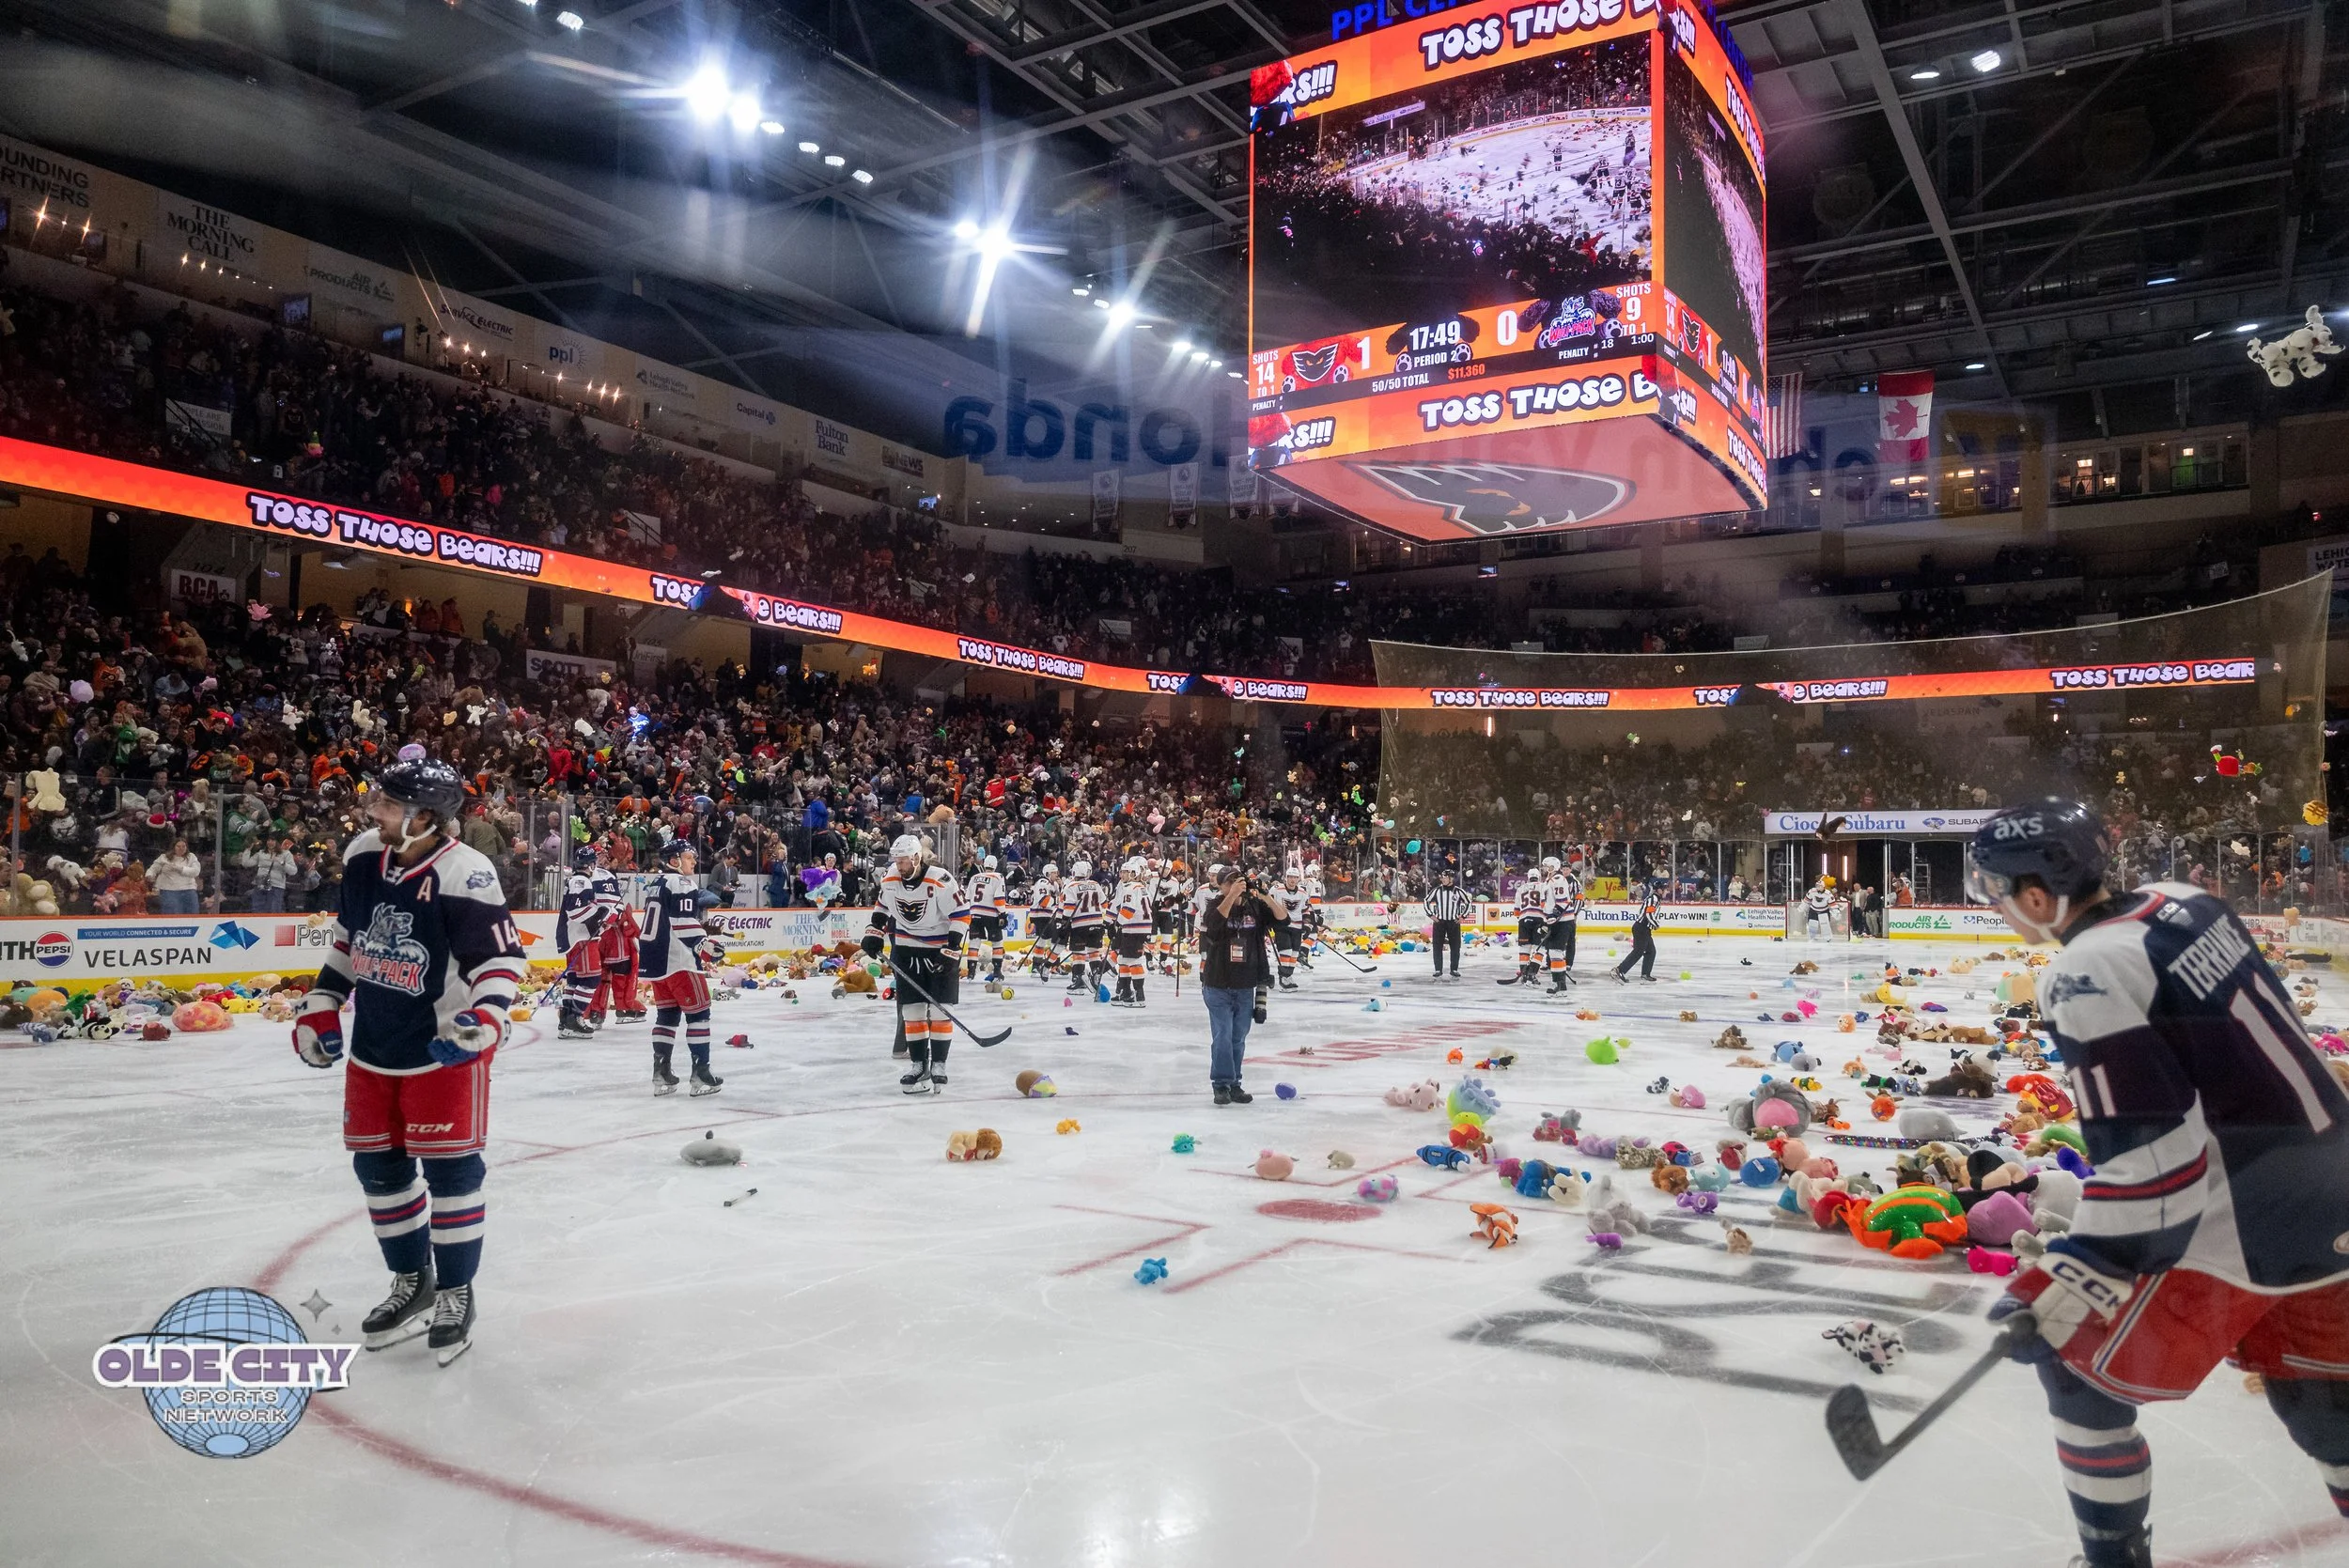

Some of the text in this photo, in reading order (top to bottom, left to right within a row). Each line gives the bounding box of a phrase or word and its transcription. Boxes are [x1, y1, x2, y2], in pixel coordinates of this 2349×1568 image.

[192, 204, 230, 229] THE
[167, 212, 255, 253] MORNING
[188, 236, 234, 261] CALL
[1617, 282, 1652, 298] SHOTS
[1626, 297, 1641, 320] 9
[1409, 320, 1461, 350] 17:49
[1497, 310, 1517, 346] 0
[1601, 339, 1613, 349] 18
[1631, 334, 1654, 345] 1:00
[549, 343, 574, 365] ppl
[1252, 350, 1279, 365] SHOTS
[1357, 336, 1370, 369] 1
[1414, 352, 1447, 367] PERIOD
[1559, 348, 1589, 359] PENALTY
[1256, 363, 1275, 385] 14
[1372, 378, 1401, 392] 50/50
[1403, 373, 1429, 387] TOTAL
[1257, 385, 1275, 397] TO 1
[737, 402, 766, 420] Capital
[1252, 400, 1276, 411] PENALTY
[815, 420, 848, 442] Fulton
[817, 435, 847, 455] Bank
[179, 575, 219, 599] BCA
[1994, 815, 2045, 840] axs
[417, 876, 432, 903] A
[602, 883, 615, 893] 30
[926, 886, 934, 898] C
[973, 884, 986, 902] 5
[575, 897, 582, 908] 4
[679, 899, 692, 911] 10
[728, 915, 772, 930] ELECTRIC
[795, 913, 815, 924] THE
[1584, 910, 1620, 922] Fulton
[1658, 912, 1679, 921] PLAY
[1688, 912, 1708, 921] WIN!
[169, 928, 193, 937] SECURE
[490, 920, 522, 955] 14
[783, 924, 825, 937] MORNING
[36, 945, 70, 955] PEPSI
[84, 946, 212, 969] VELASPAN
[380, 956, 424, 989] PACK
[2070, 1063, 2118, 1121] 11
[406, 1122, 455, 1134] CCM
